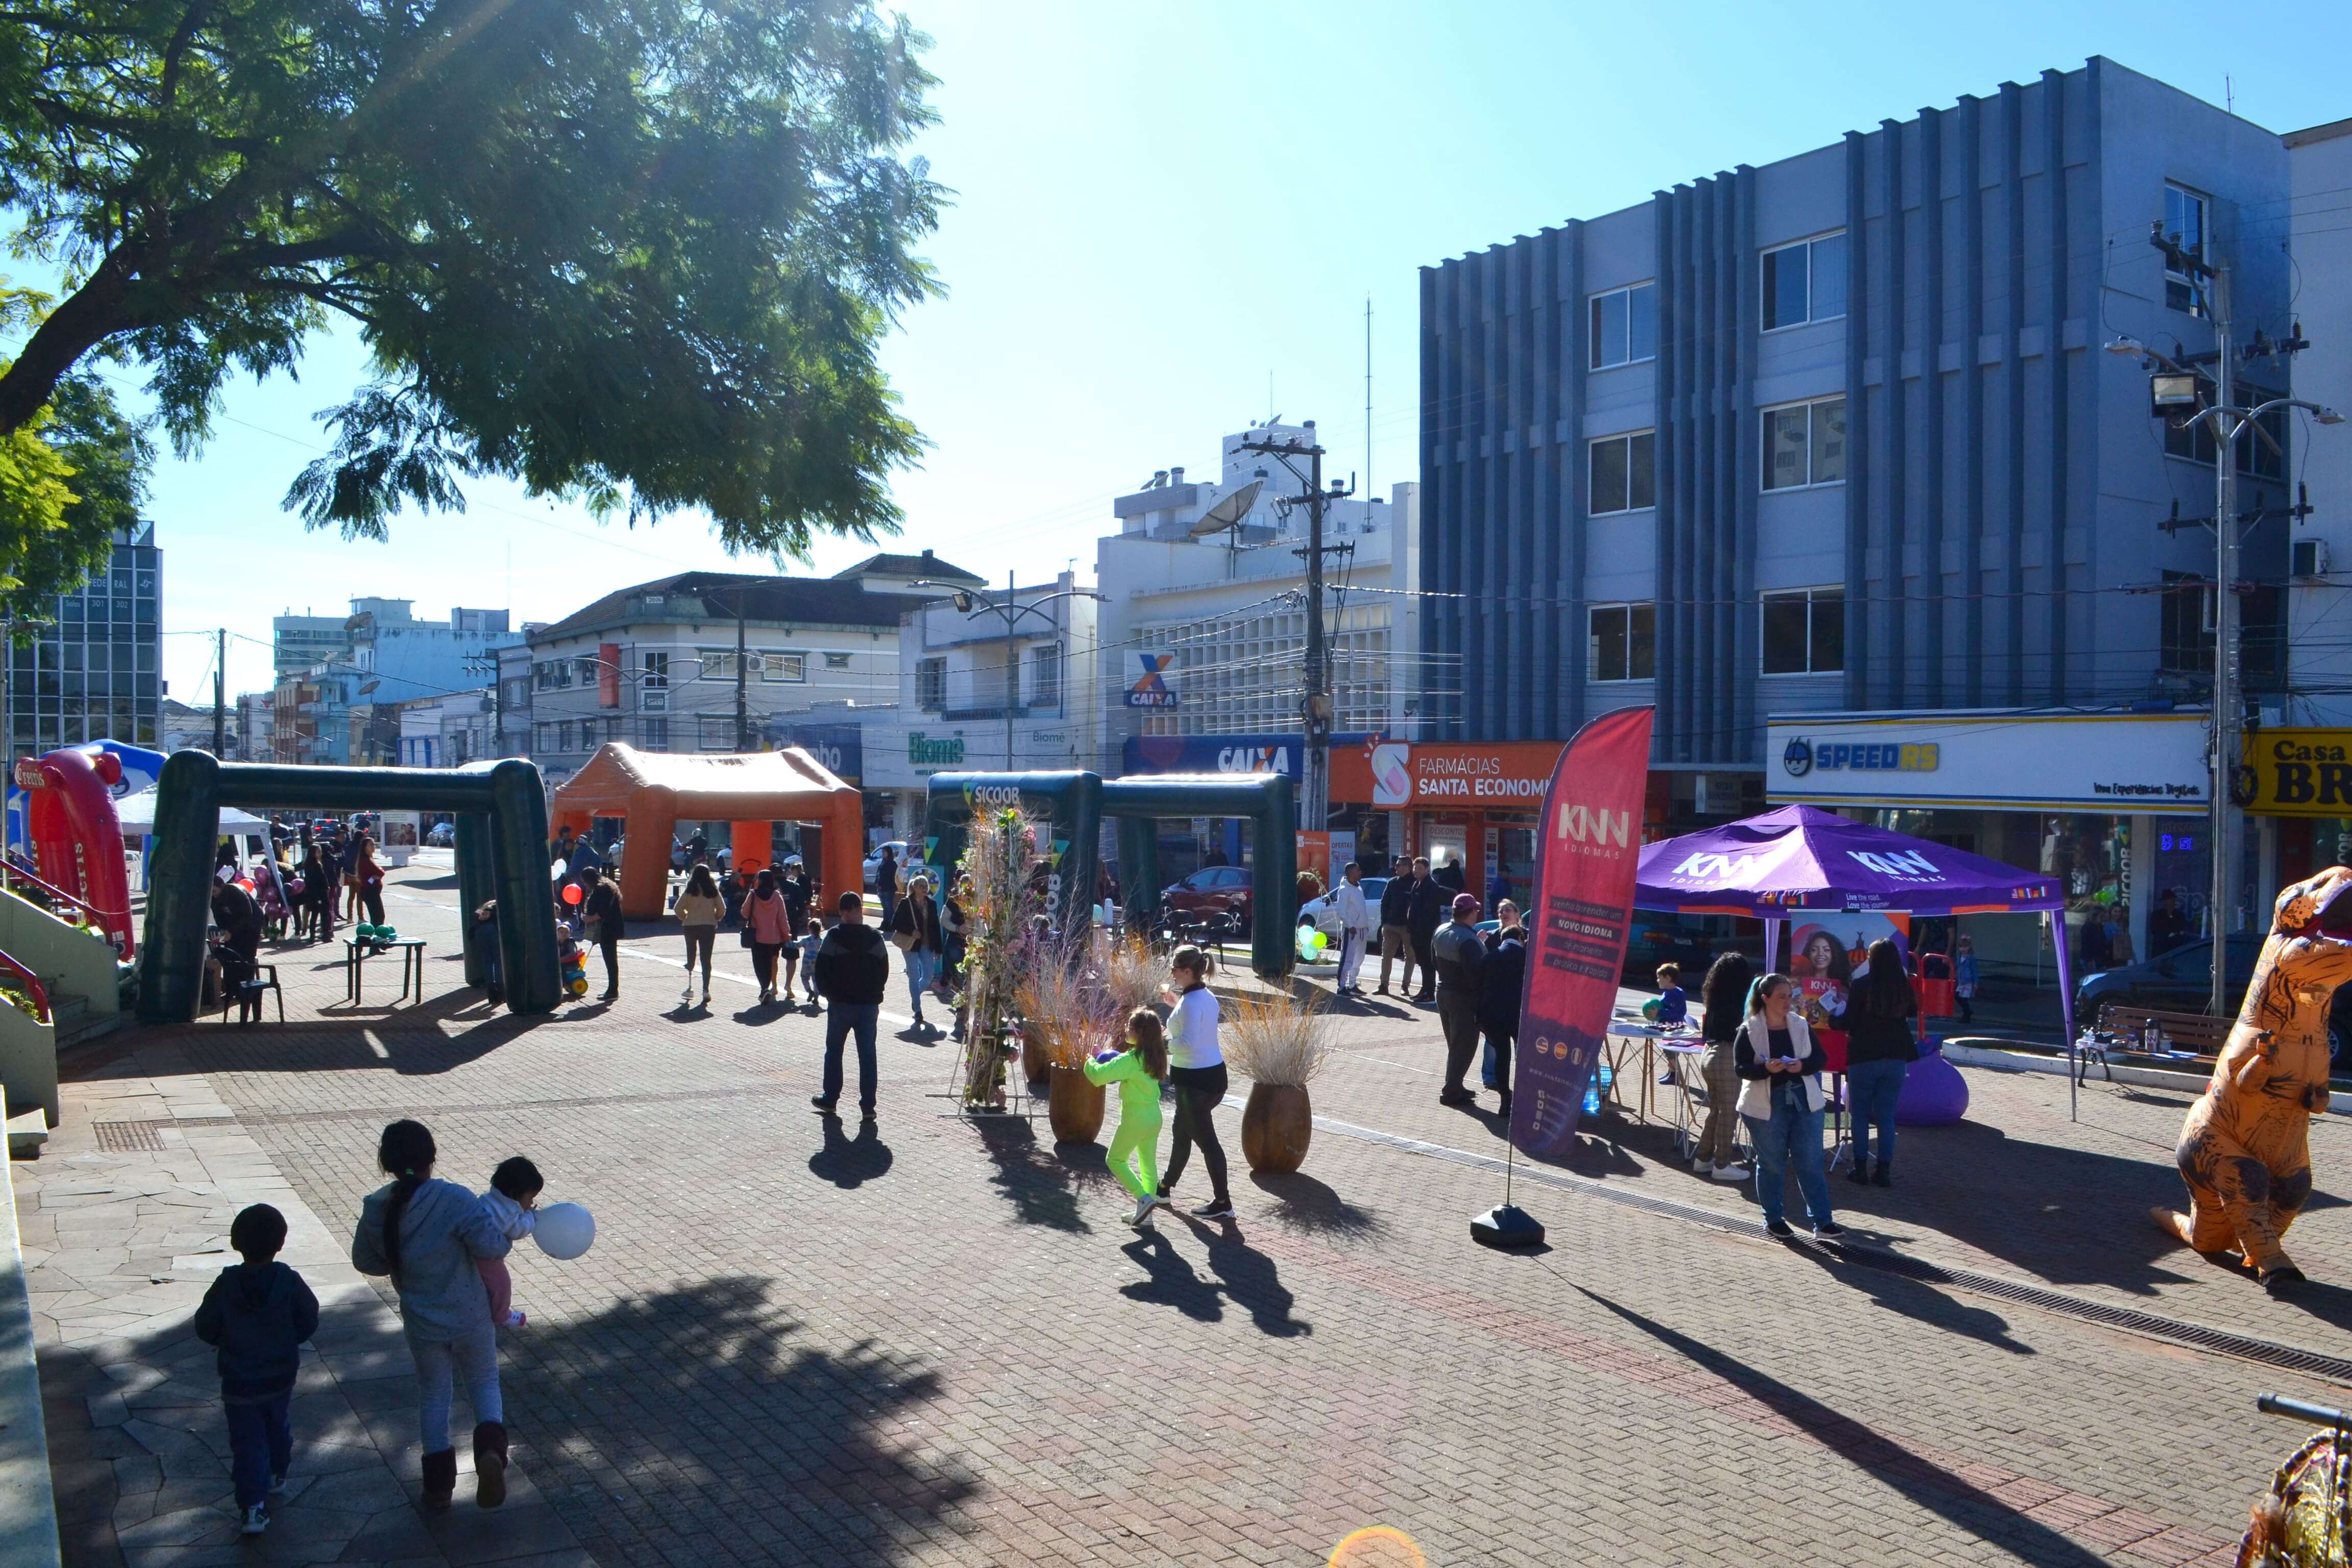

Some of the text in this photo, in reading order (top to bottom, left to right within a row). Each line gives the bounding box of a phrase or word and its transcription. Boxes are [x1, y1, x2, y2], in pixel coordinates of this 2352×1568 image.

[1131, 693, 1174, 706] CAIXA
[2273, 740, 2346, 761] Casa
[1217, 747, 1289, 773] CAIXA
[1418, 753, 1500, 775] FARMÁCIAS
[975, 786, 1020, 804] SICOOB
[1418, 778, 1550, 796] SANTA ECONOMI
[1558, 803, 1629, 848] KNN
[1564, 843, 1620, 860] IDIOMAS
[1846, 849, 1940, 875] KNN
[1889, 874, 1947, 883] IDIOMAS
[1846, 893, 1858, 901] Live
[1558, 919, 1613, 939] NOVO IDIOMA
[1810, 980, 1832, 990] KNN
